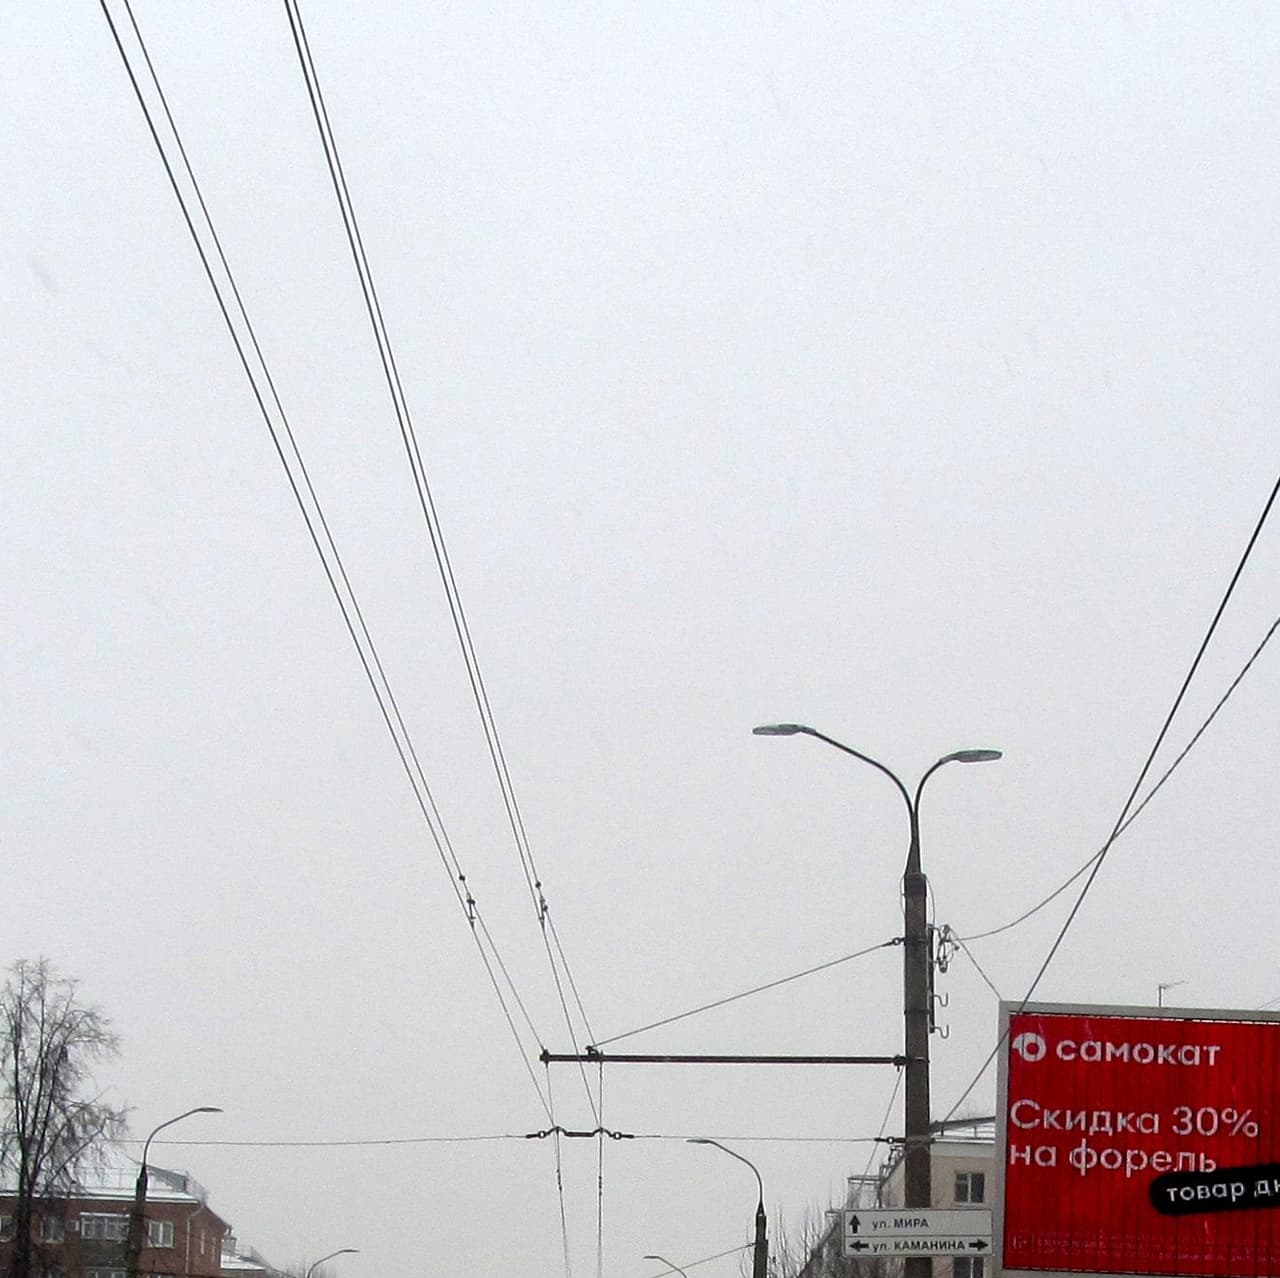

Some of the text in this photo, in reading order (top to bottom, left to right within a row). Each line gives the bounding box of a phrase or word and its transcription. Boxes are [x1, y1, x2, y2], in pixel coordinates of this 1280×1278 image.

[1056, 1039, 1221, 1067] самокат
[1010, 1099, 1259, 1138] Скидка 30%
[1009, 1138, 1217, 1178] на форель
[1166, 1182, 1245, 1203] товар
[872, 1218, 929, 1231] ул. МИРА
[872, 1240, 966, 1253] ул. КАМАНИНА
